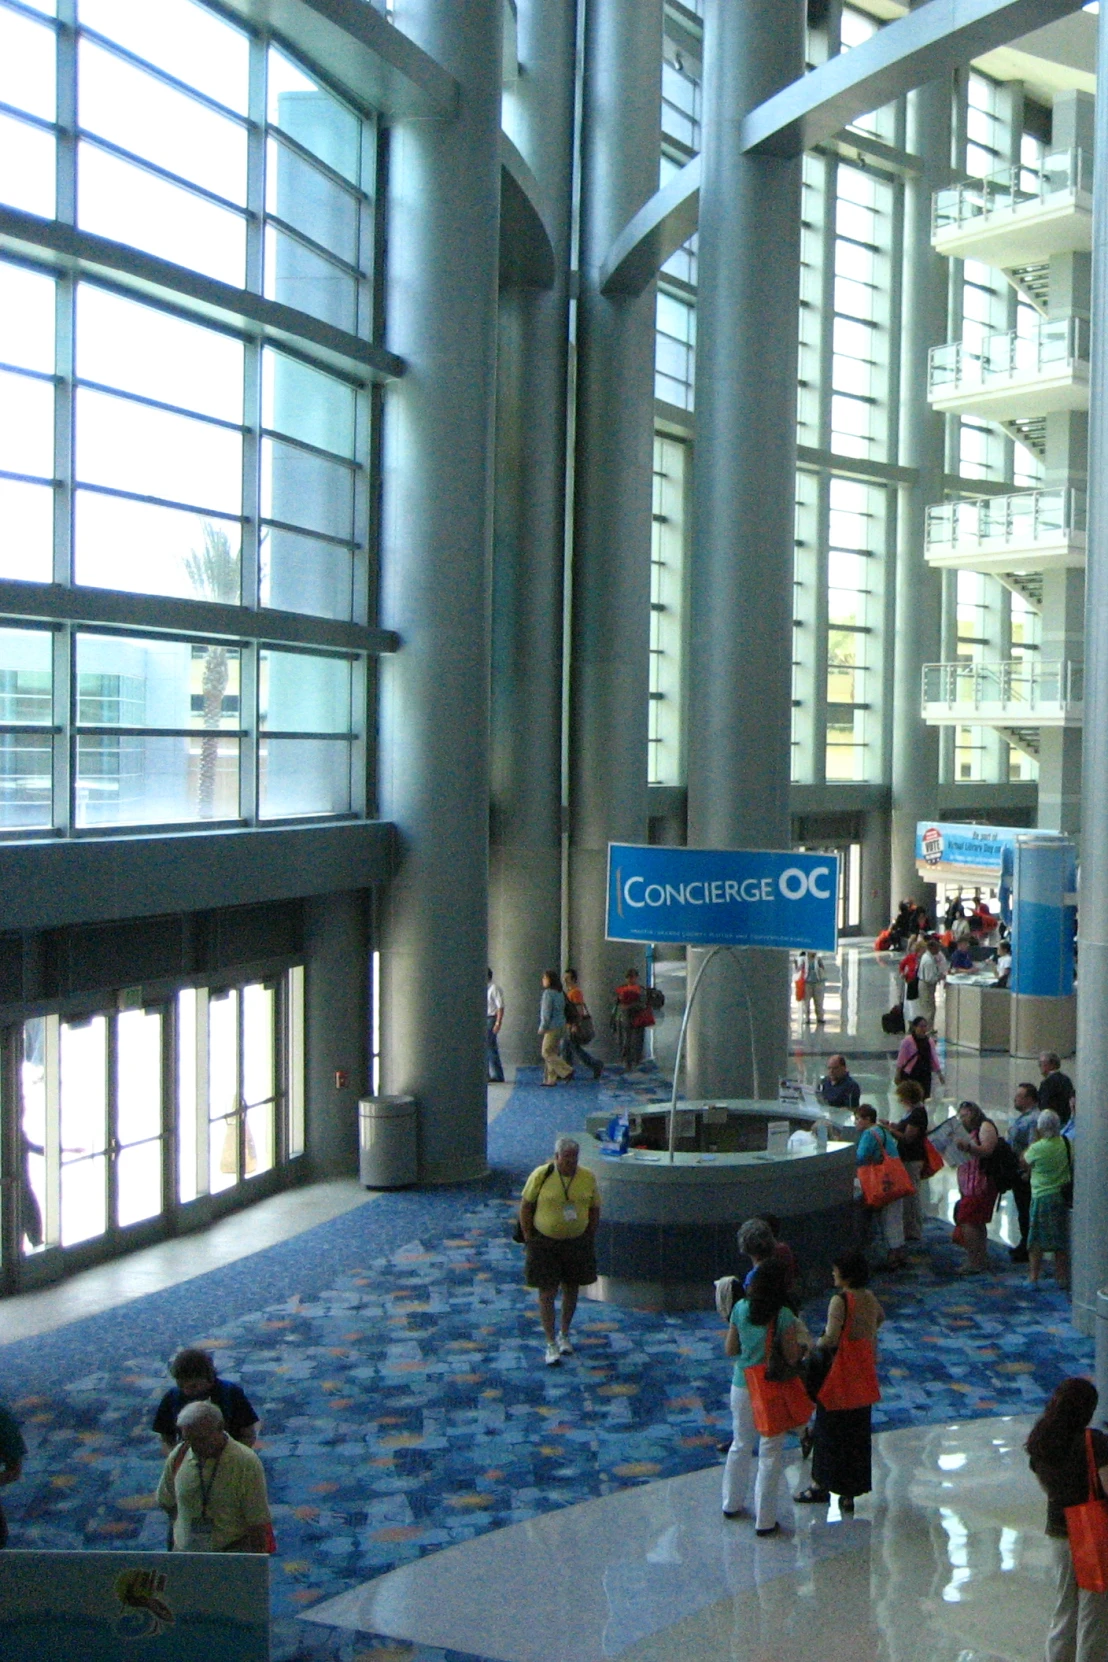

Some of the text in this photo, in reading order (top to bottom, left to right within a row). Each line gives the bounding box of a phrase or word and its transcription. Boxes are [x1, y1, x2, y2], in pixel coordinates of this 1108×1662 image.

[924, 839, 942, 854] VOTE
[623, 866, 831, 908] CONCIERGE OC
